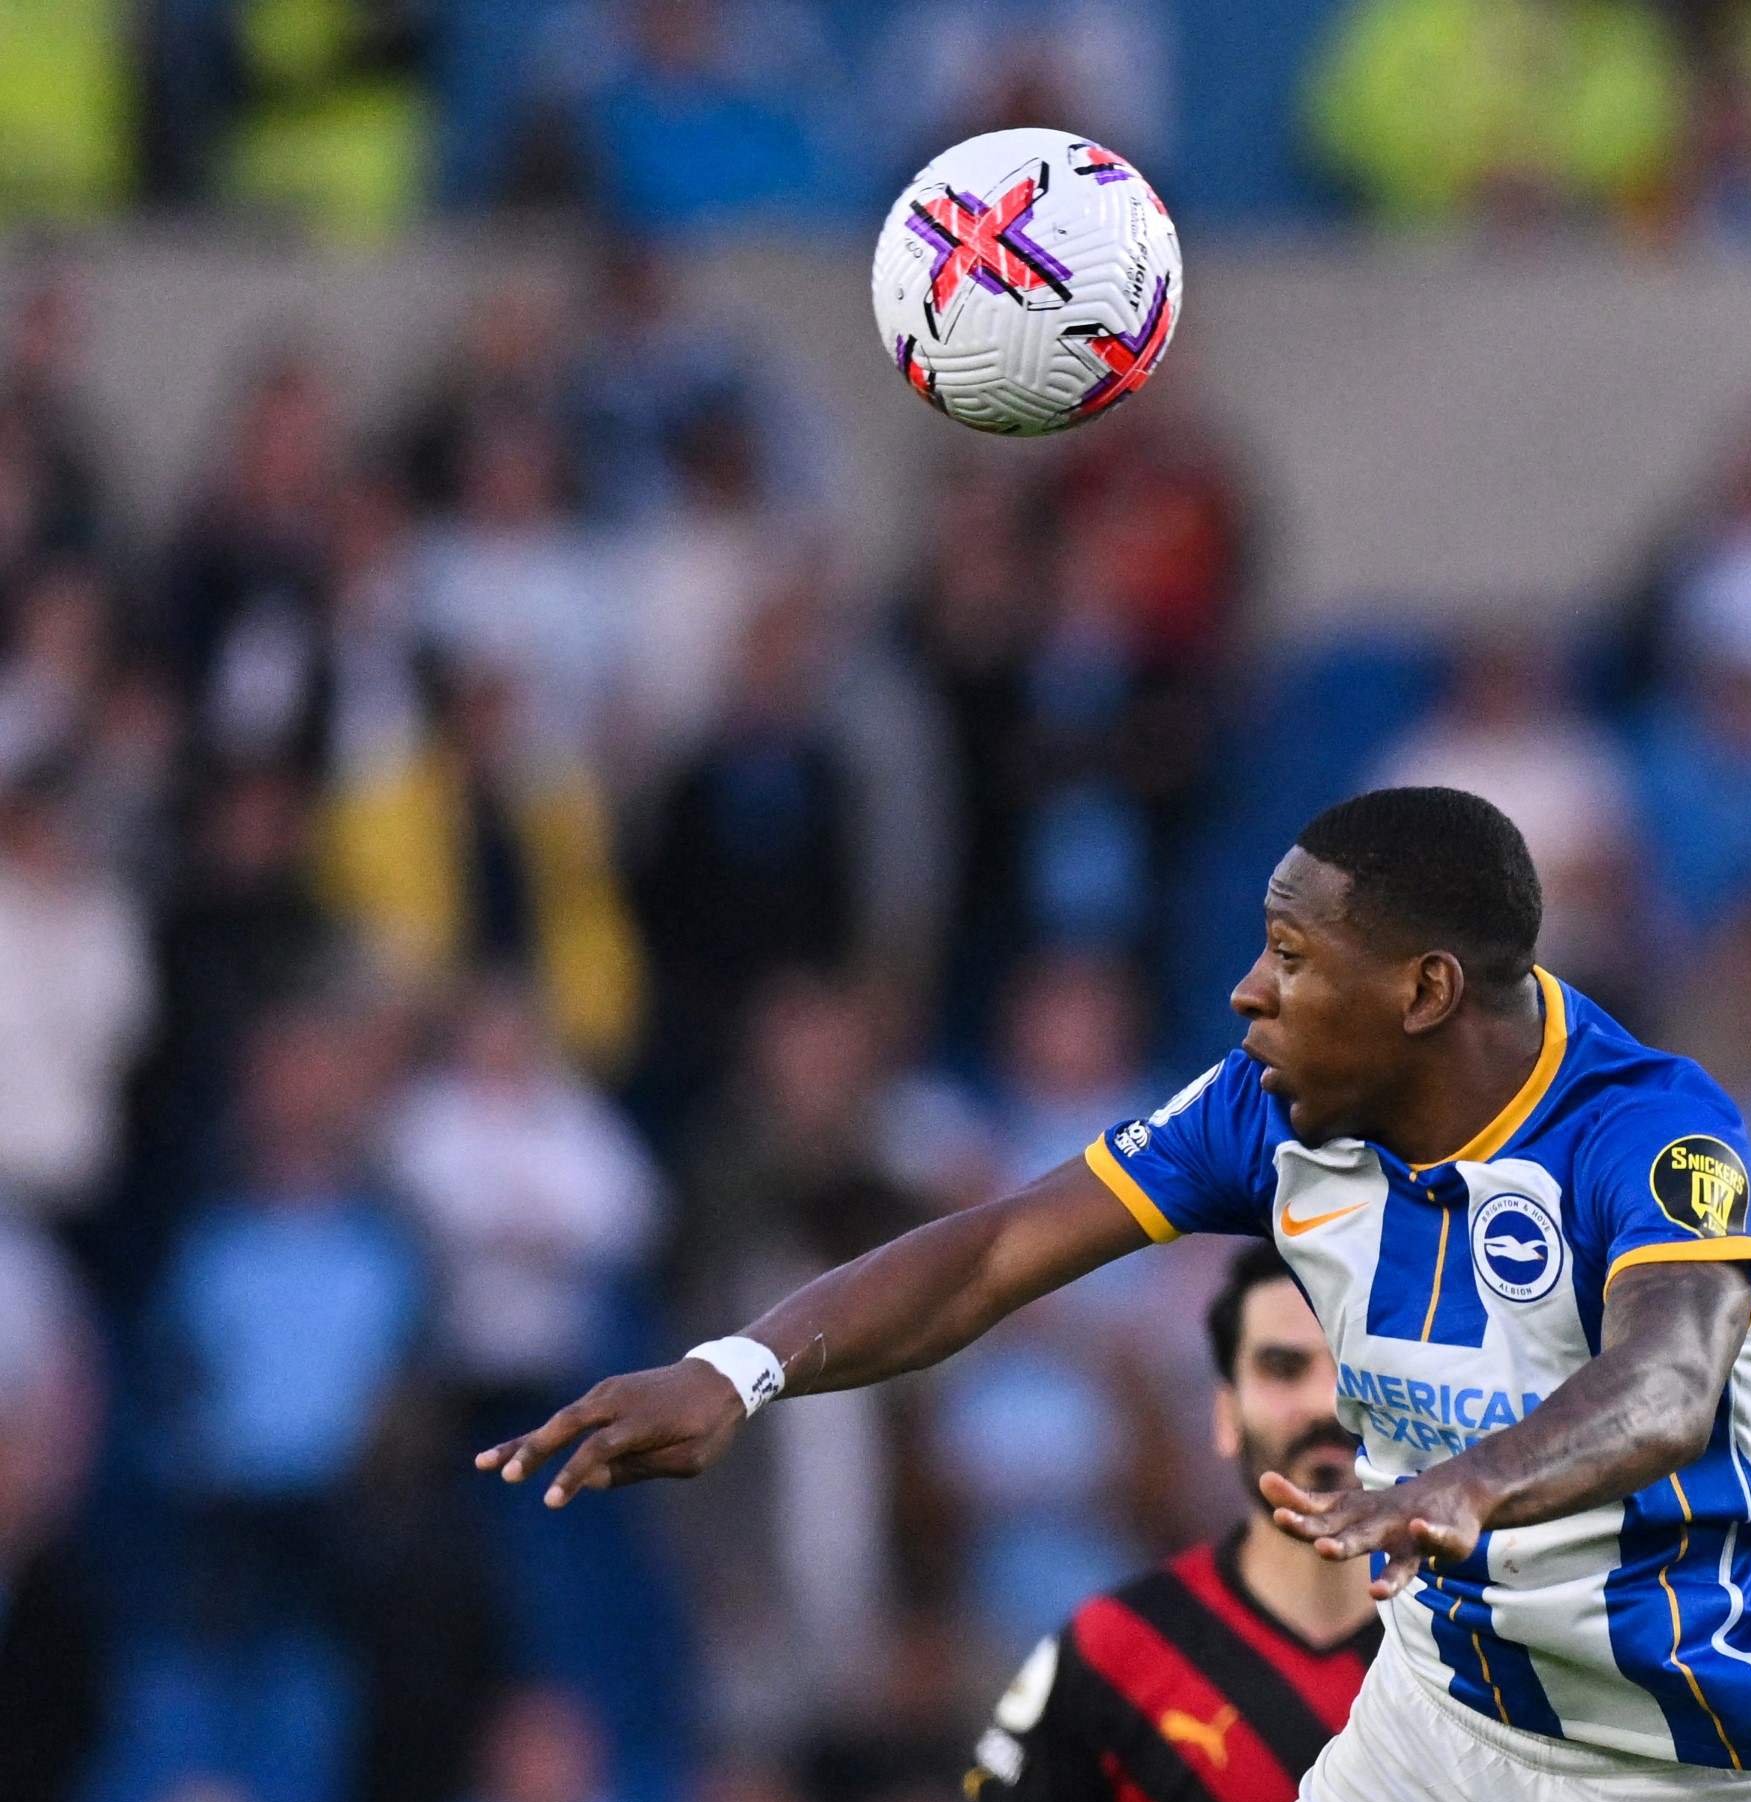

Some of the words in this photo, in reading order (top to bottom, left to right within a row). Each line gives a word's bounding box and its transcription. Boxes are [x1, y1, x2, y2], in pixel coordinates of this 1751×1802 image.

[1671, 1147, 1745, 1196] SNICKERS
[1482, 1199, 1519, 1223] BRIGHTON
[1523, 1203, 1531, 1212] &
[1532, 1210, 1551, 1232] HOVE
[1699, 1177, 1729, 1222] UK
[1499, 1283, 1532, 1296] ALBION
